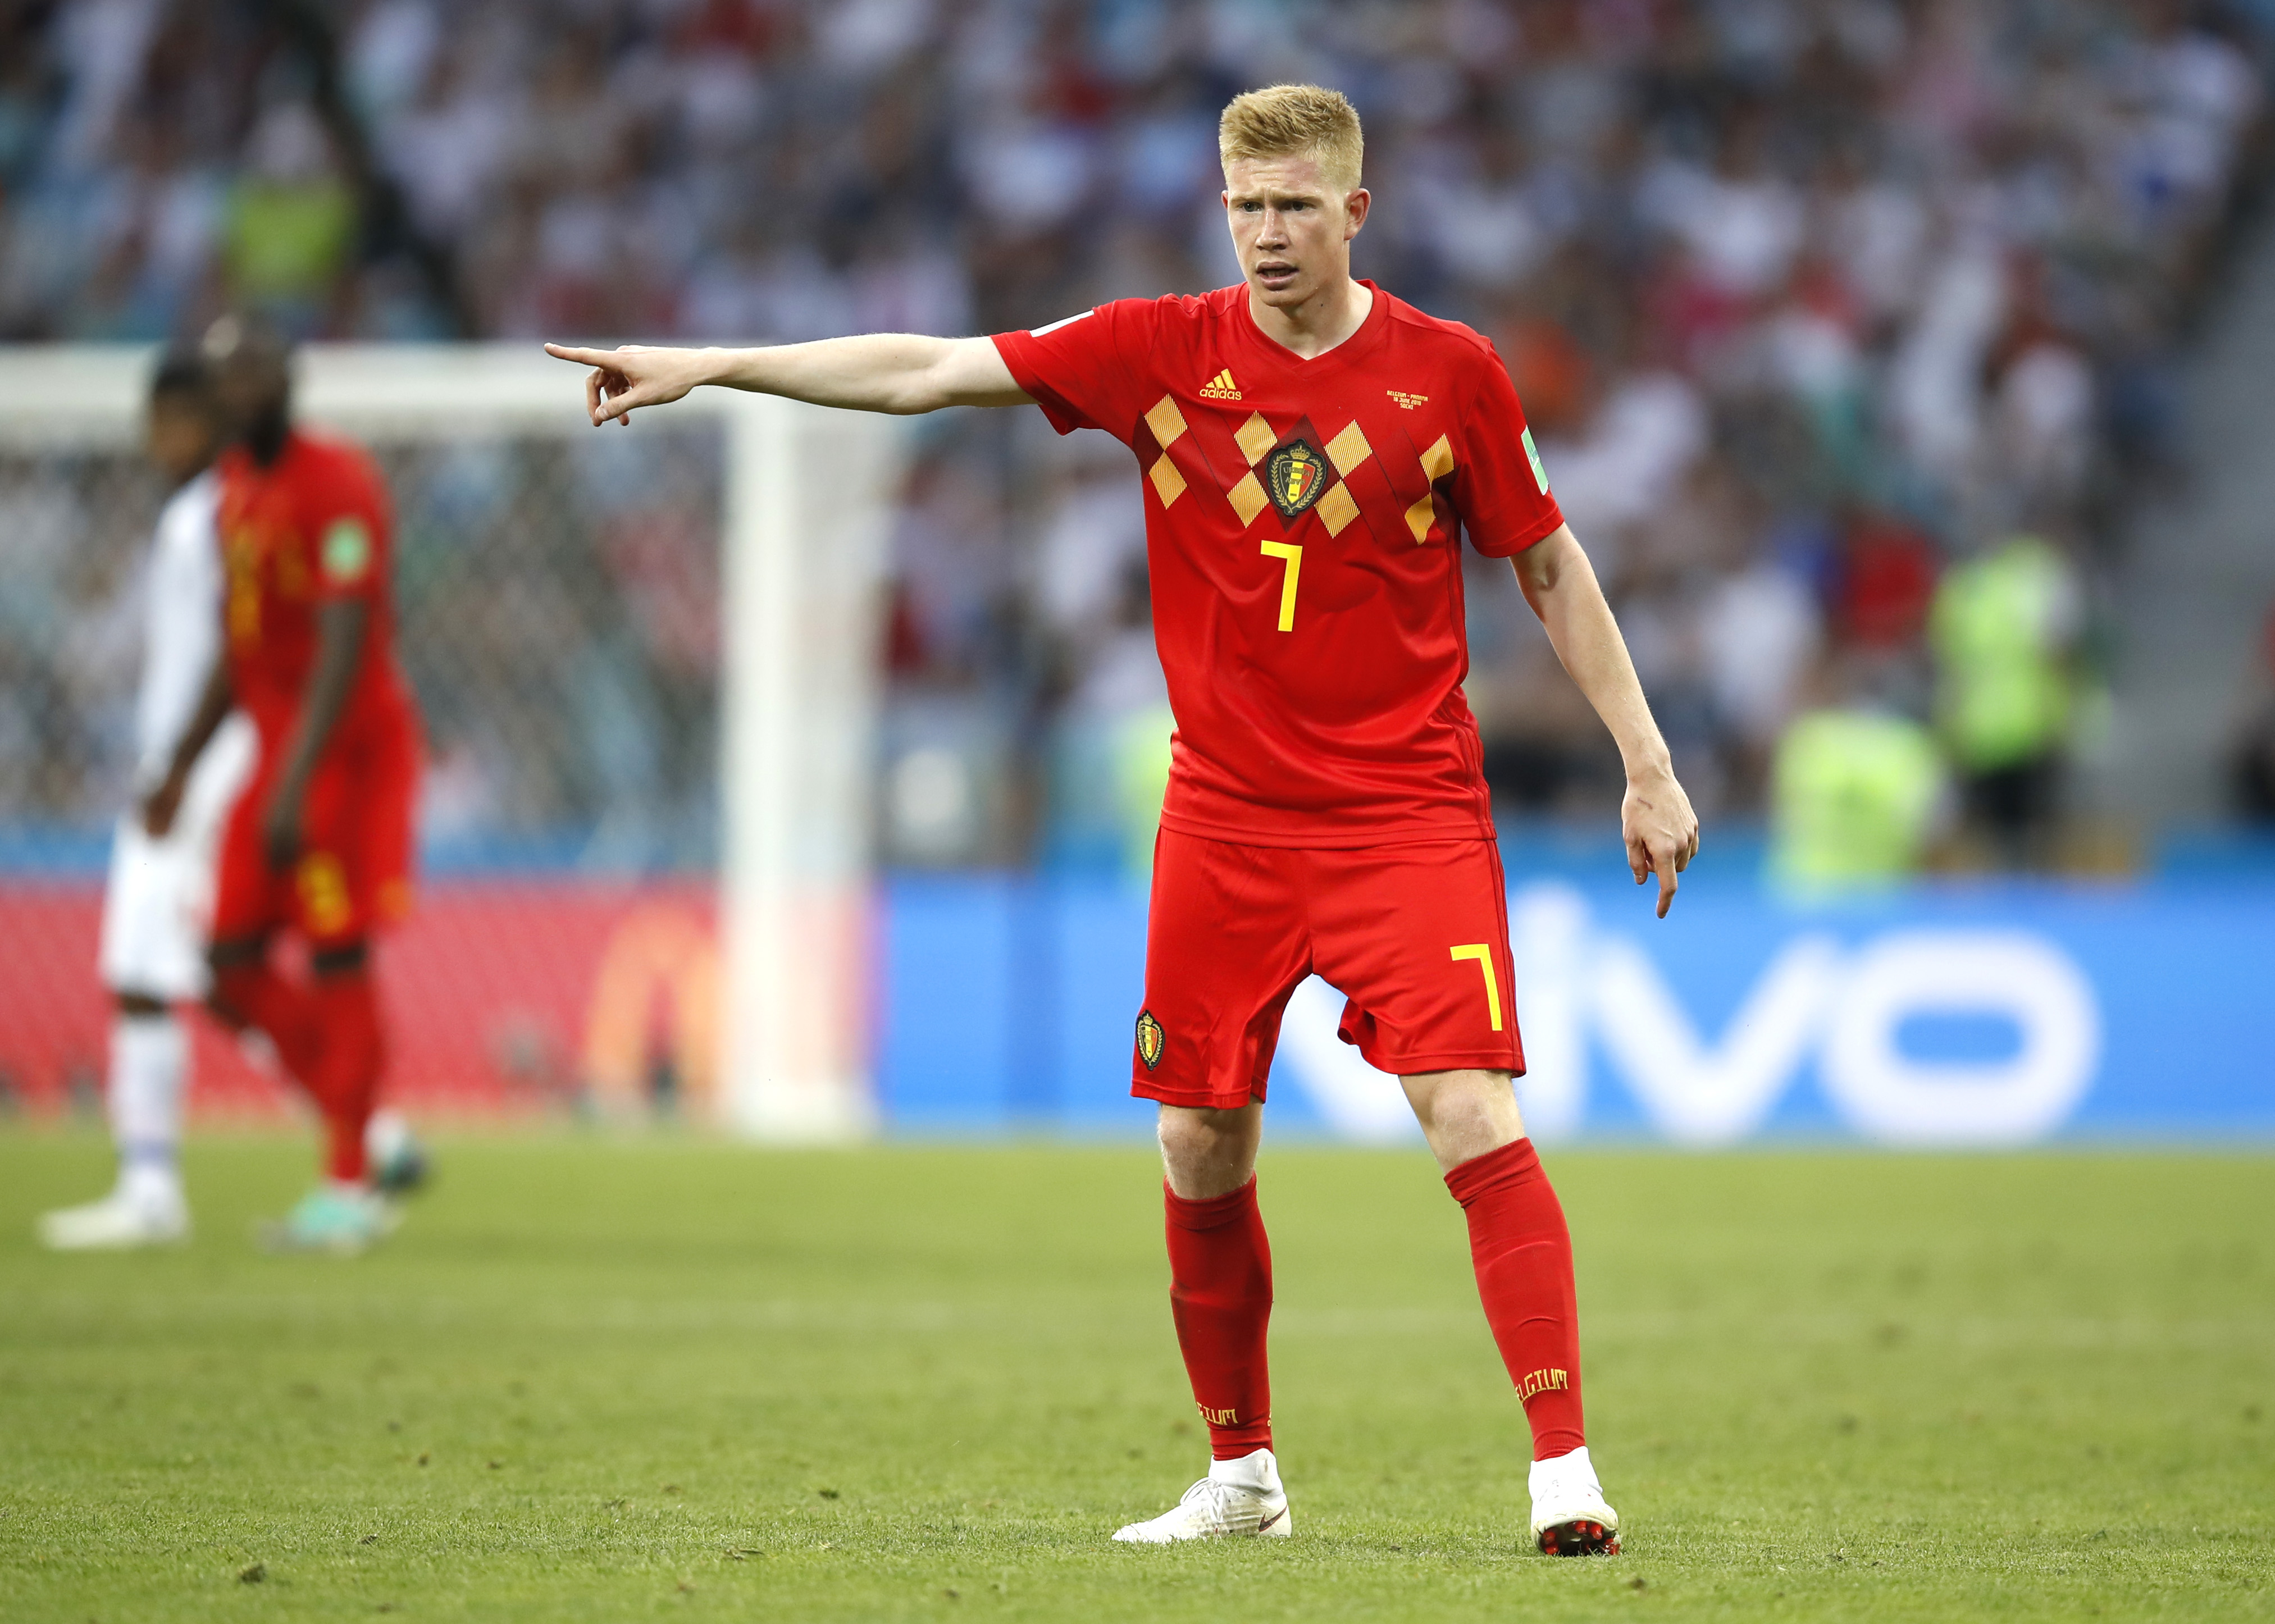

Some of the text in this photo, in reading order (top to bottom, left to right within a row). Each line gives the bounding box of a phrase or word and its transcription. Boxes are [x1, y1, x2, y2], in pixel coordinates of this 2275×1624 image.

[1199, 387, 1242, 400] adidas
[1410, 394, 1428, 402] PANAMA
[1260, 540, 1303, 632] 7
[1449, 943, 1503, 1031] 7
